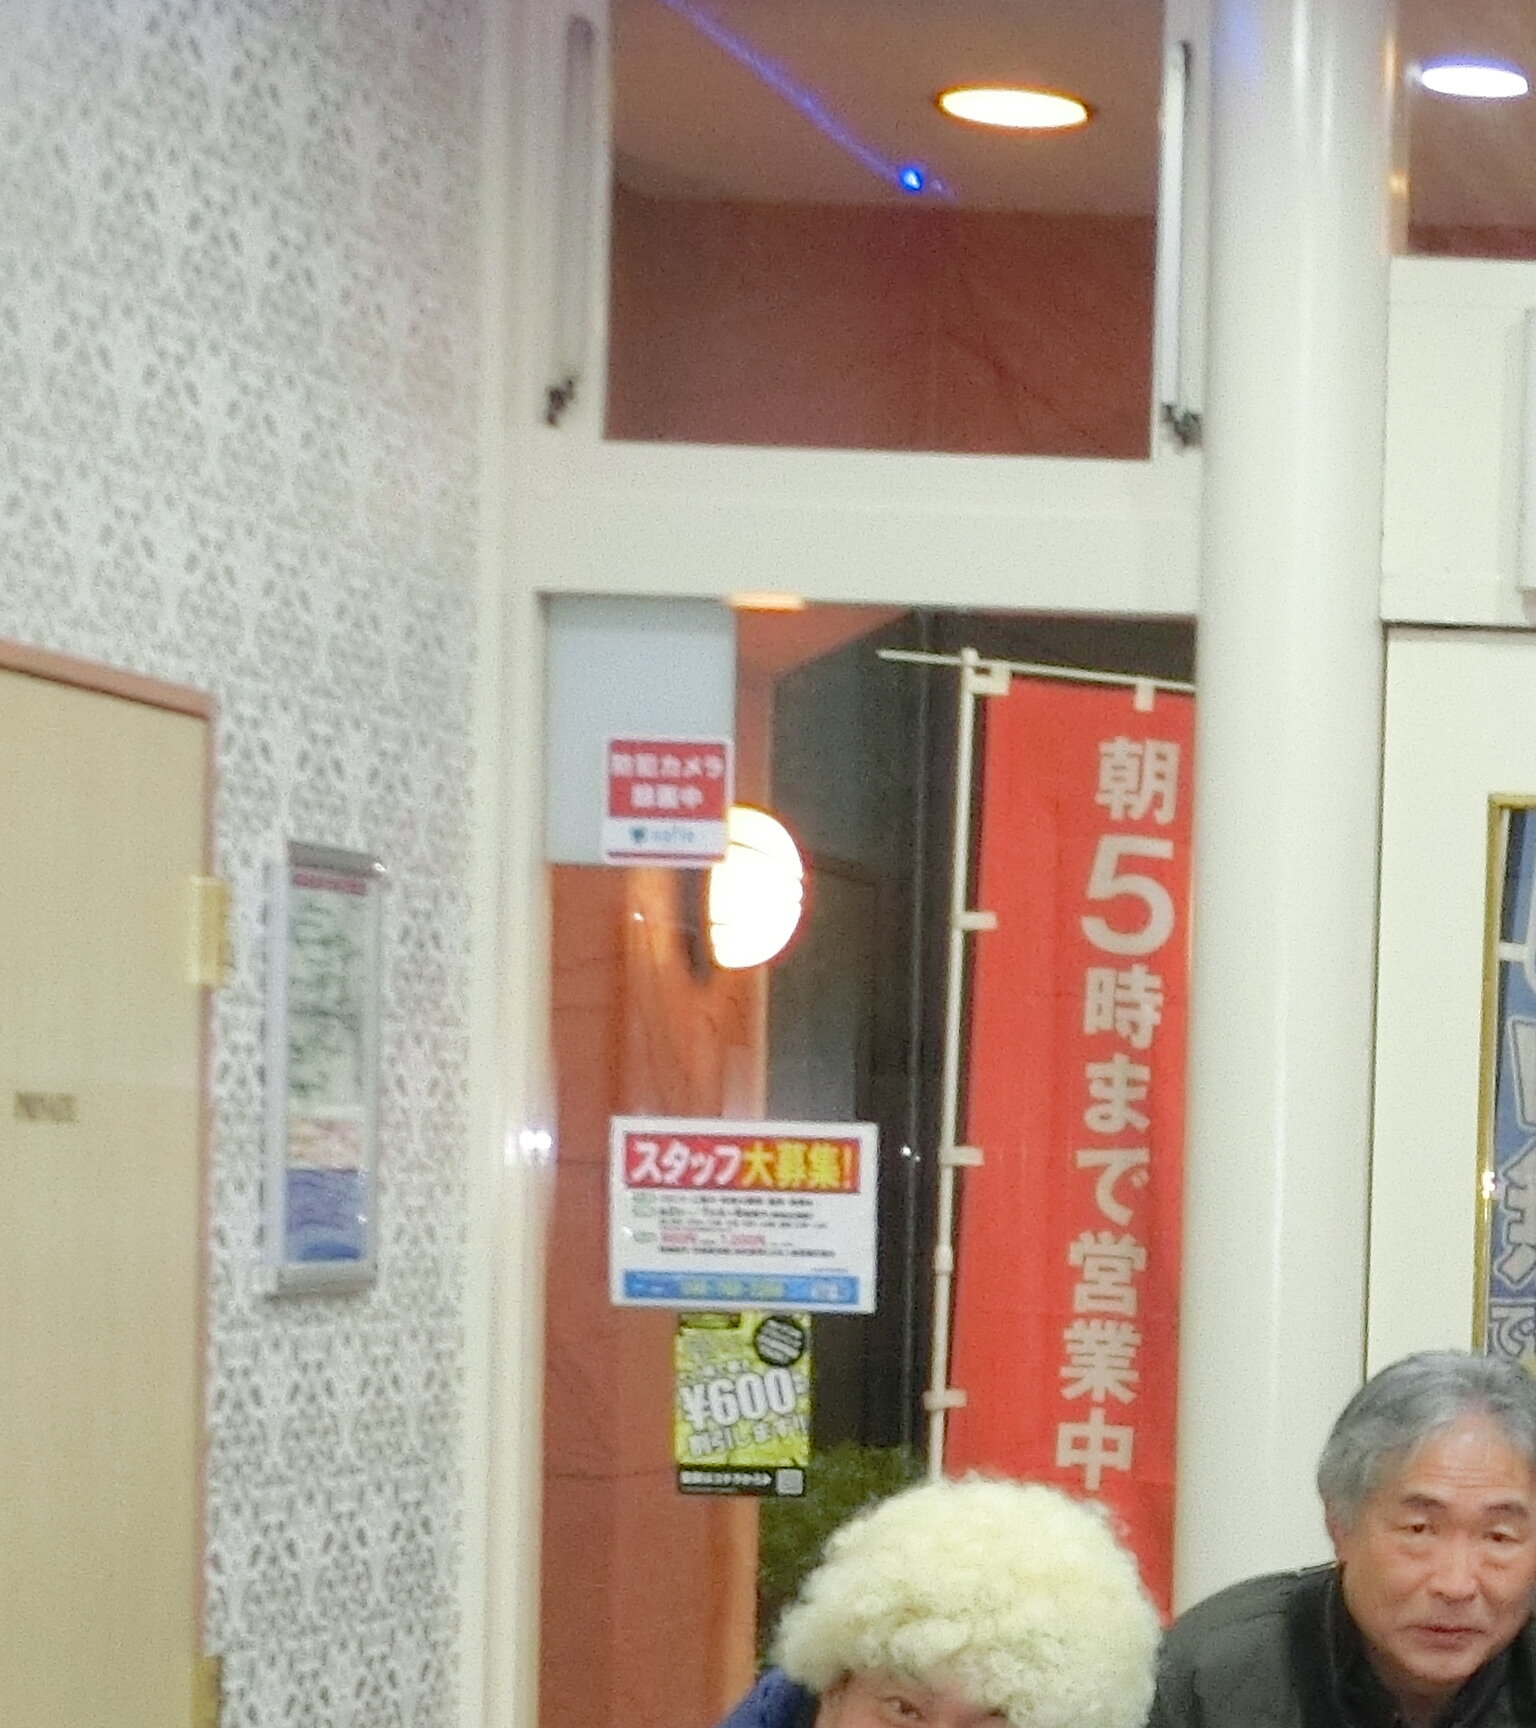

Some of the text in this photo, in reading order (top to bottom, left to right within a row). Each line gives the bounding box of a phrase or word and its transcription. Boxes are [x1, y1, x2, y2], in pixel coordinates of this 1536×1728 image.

[1055, 736, 1180, 1491] 朝5時まで営業中
